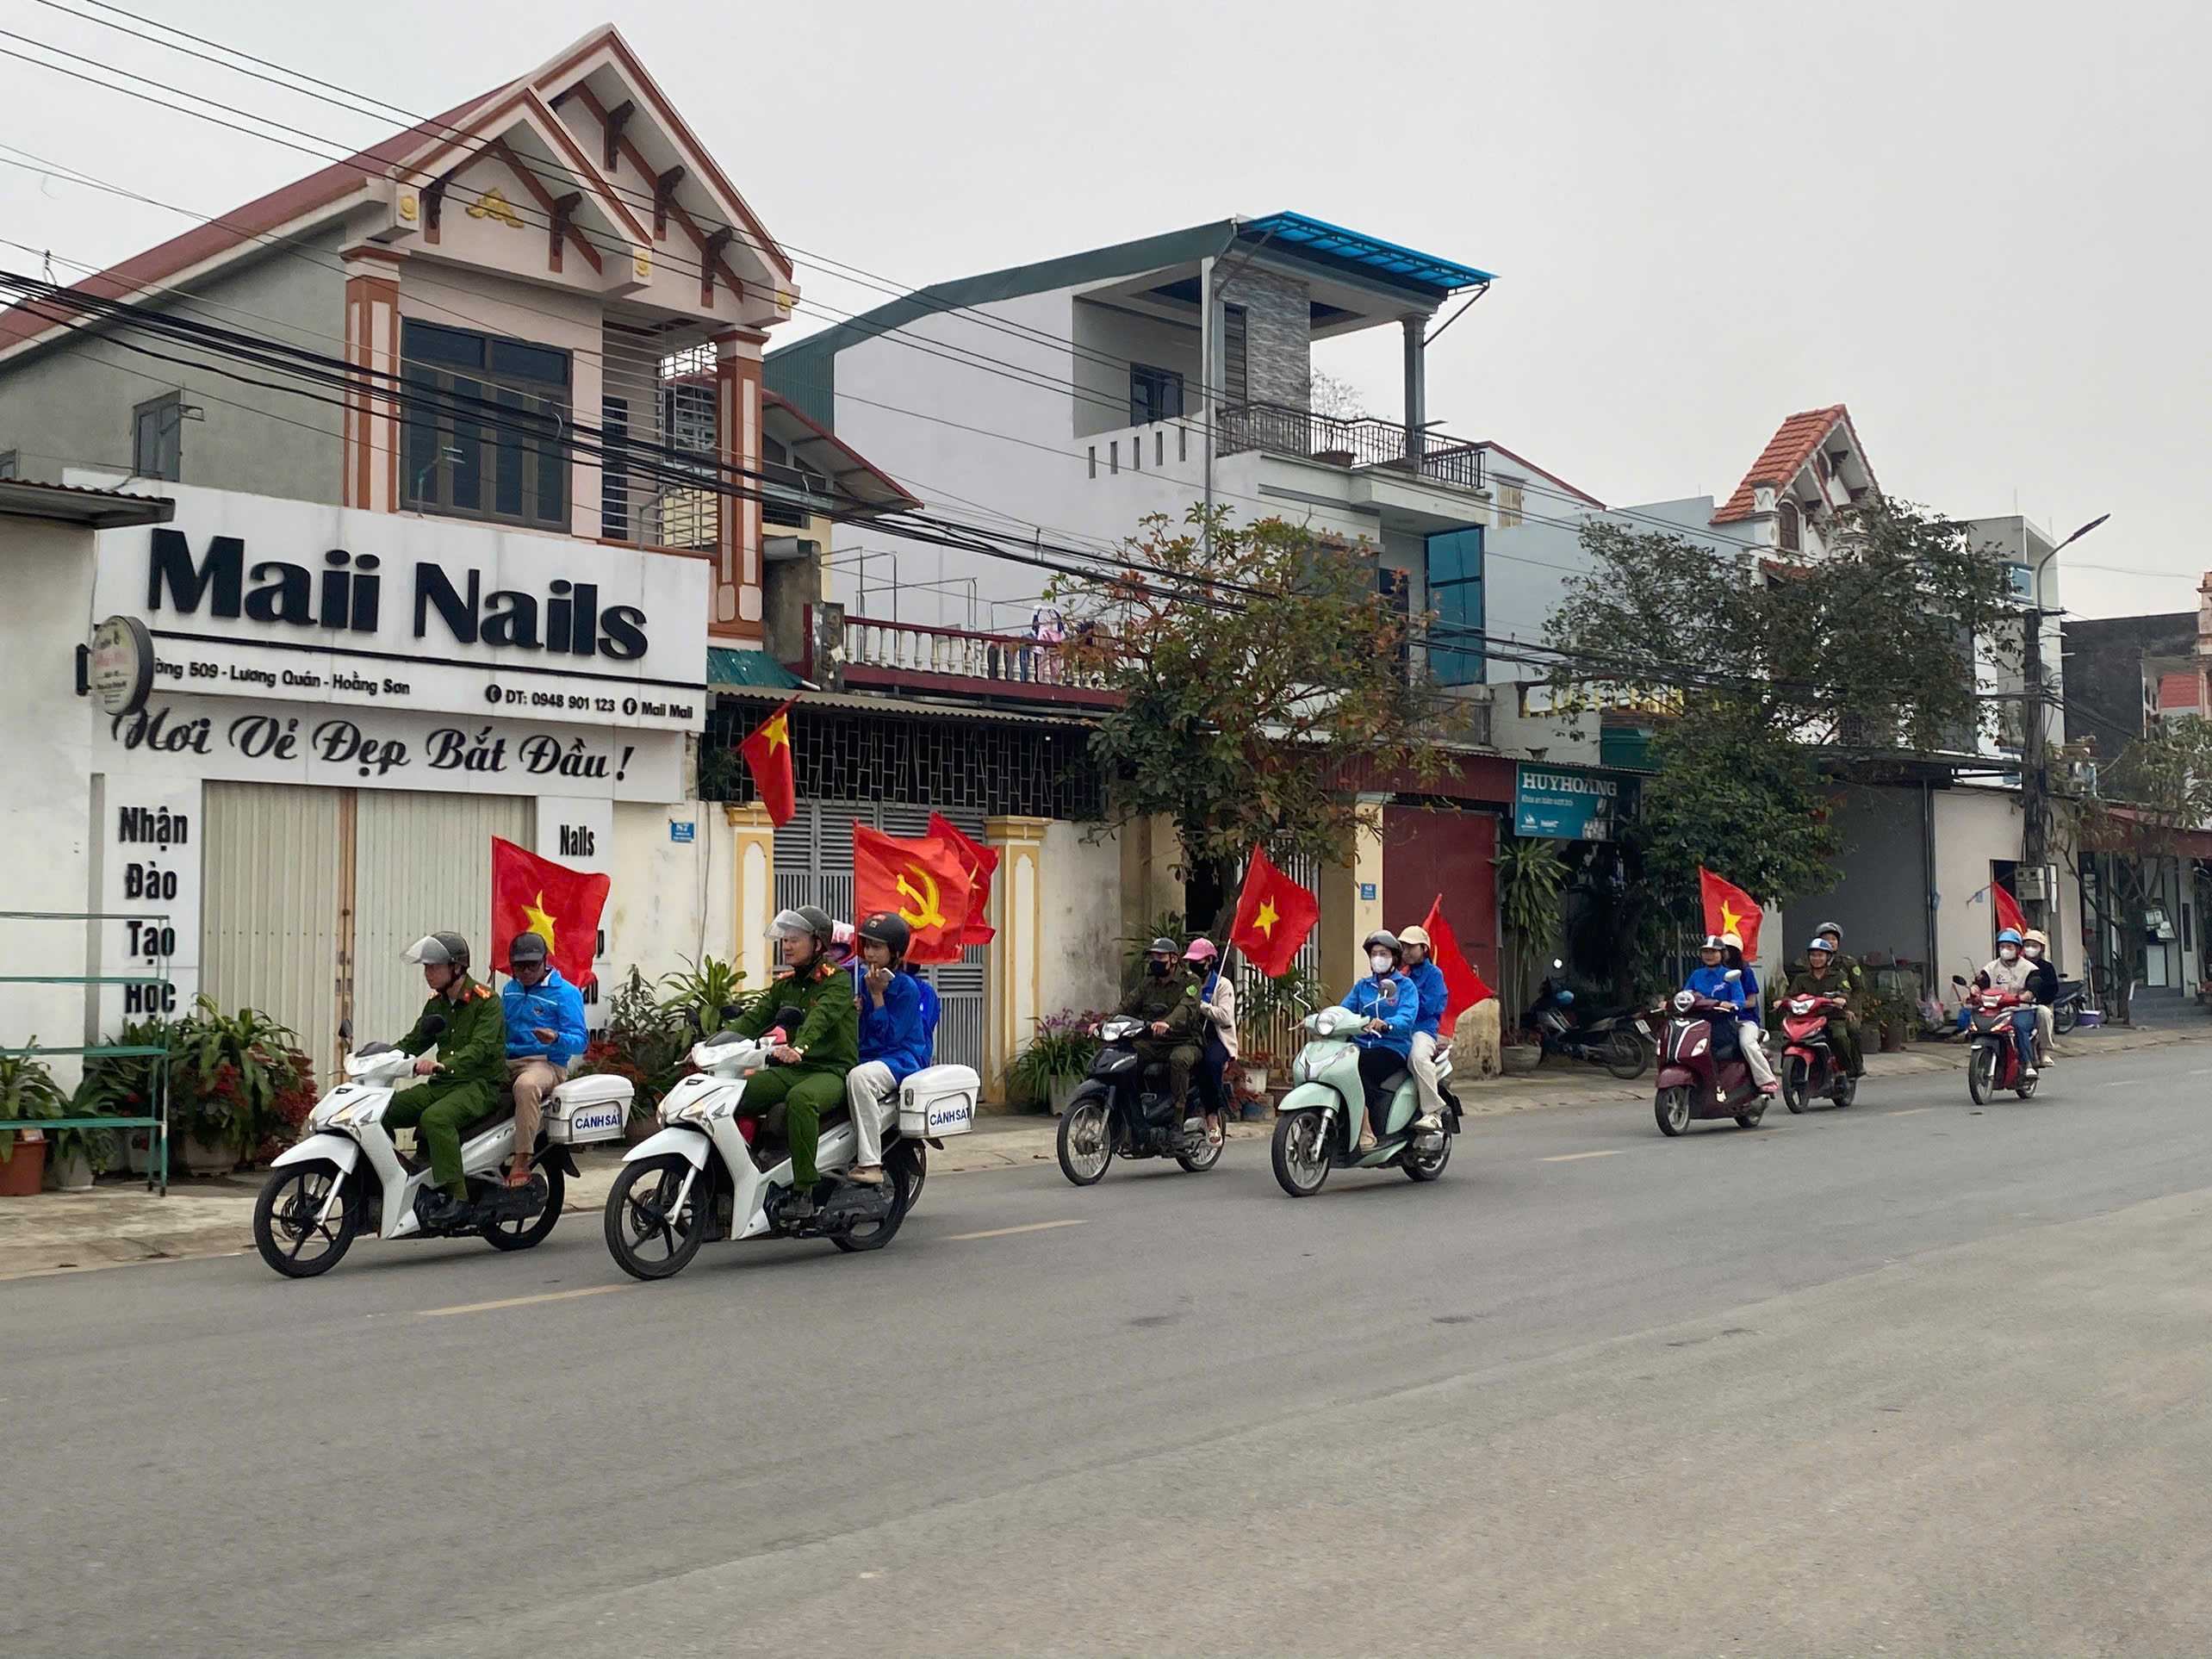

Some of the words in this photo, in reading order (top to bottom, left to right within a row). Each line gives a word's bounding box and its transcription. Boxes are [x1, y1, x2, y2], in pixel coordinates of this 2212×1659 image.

[148, 527, 380, 631] Maii
[414, 562, 648, 660] Nails
[190, 662, 219, 679] 509
[230, 665, 276, 688] Lương
[283, 670, 320, 688] Quán
[531, 692, 564, 709] 0948
[569, 695, 589, 711] 901
[595, 699, 615, 713] 123
[111, 707, 212, 755] Nơi
[228, 715, 298, 761] Vẻ
[312, 720, 411, 777] Đẹp
[426, 726, 508, 773] Bắt
[119, 805, 189, 852] Nhận
[560, 824, 595, 857] Nails
[125, 861, 177, 900] Đào
[127, 921, 176, 965] Tạo
[125, 982, 177, 1020] Học
